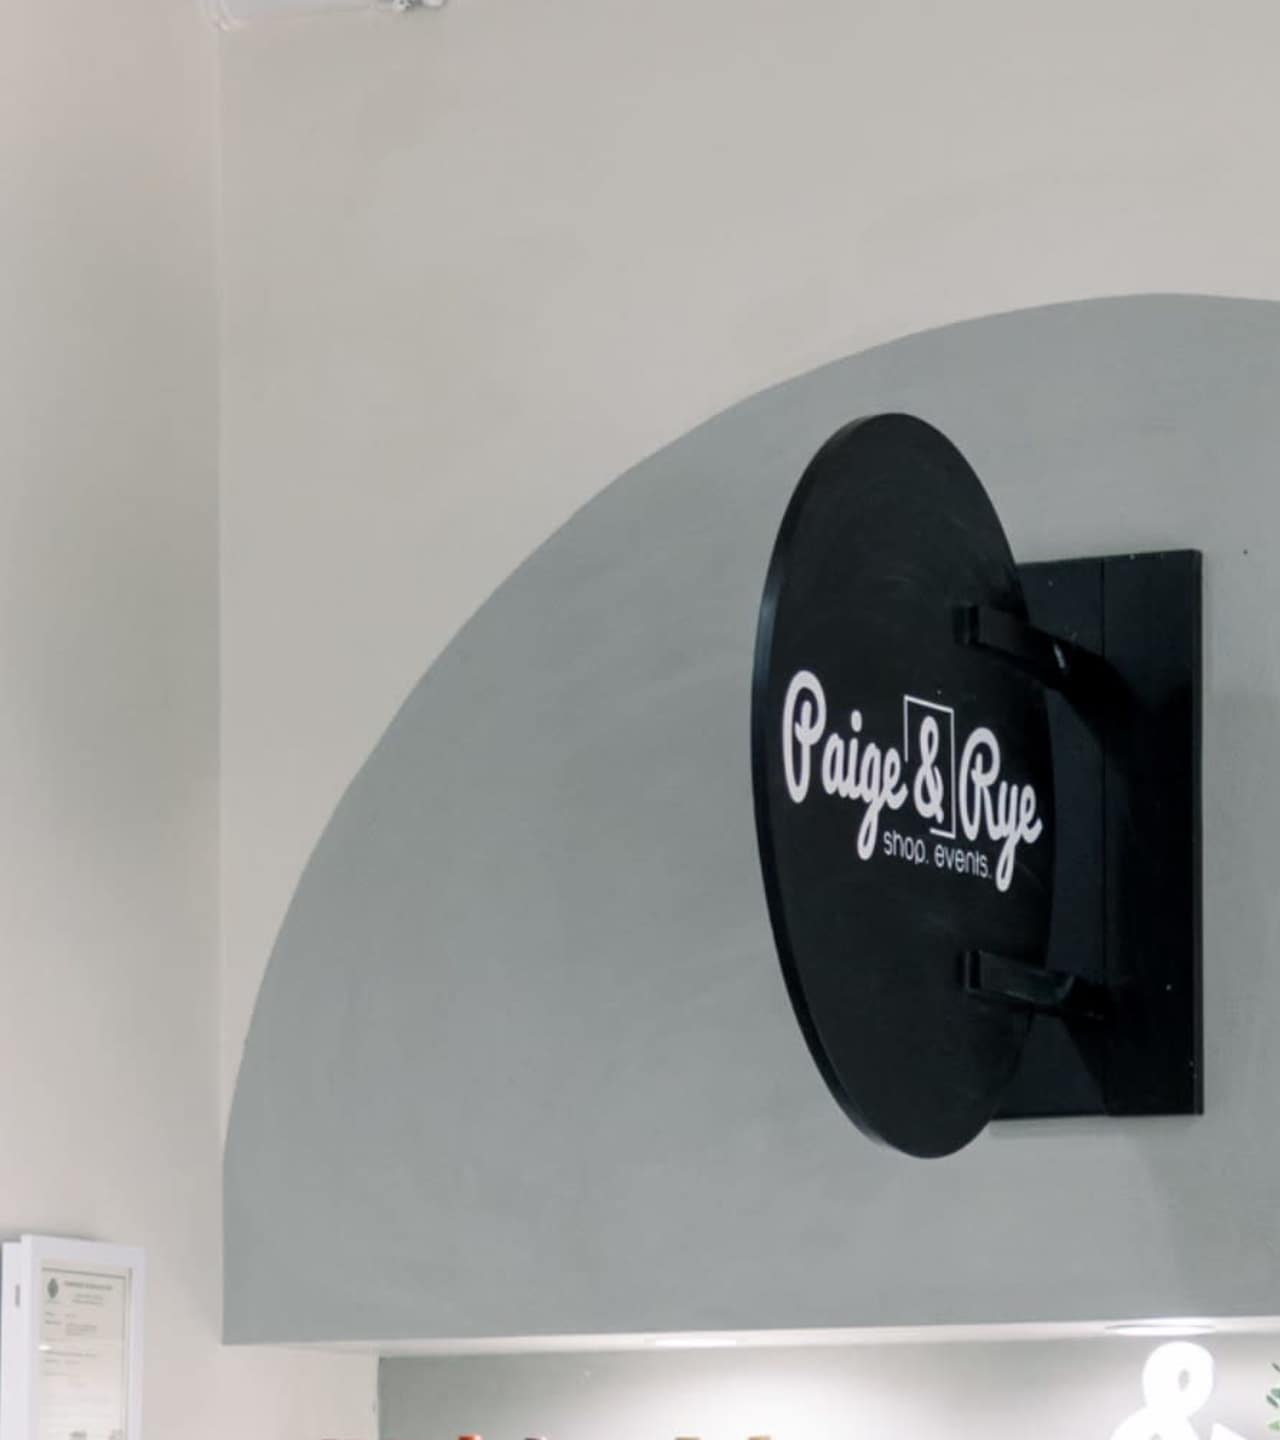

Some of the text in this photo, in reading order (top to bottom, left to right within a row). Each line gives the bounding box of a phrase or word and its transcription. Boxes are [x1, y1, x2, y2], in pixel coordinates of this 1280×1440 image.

[781, 669, 1043, 893] Paige & Rye
[882, 828, 993, 880] shop. events.
